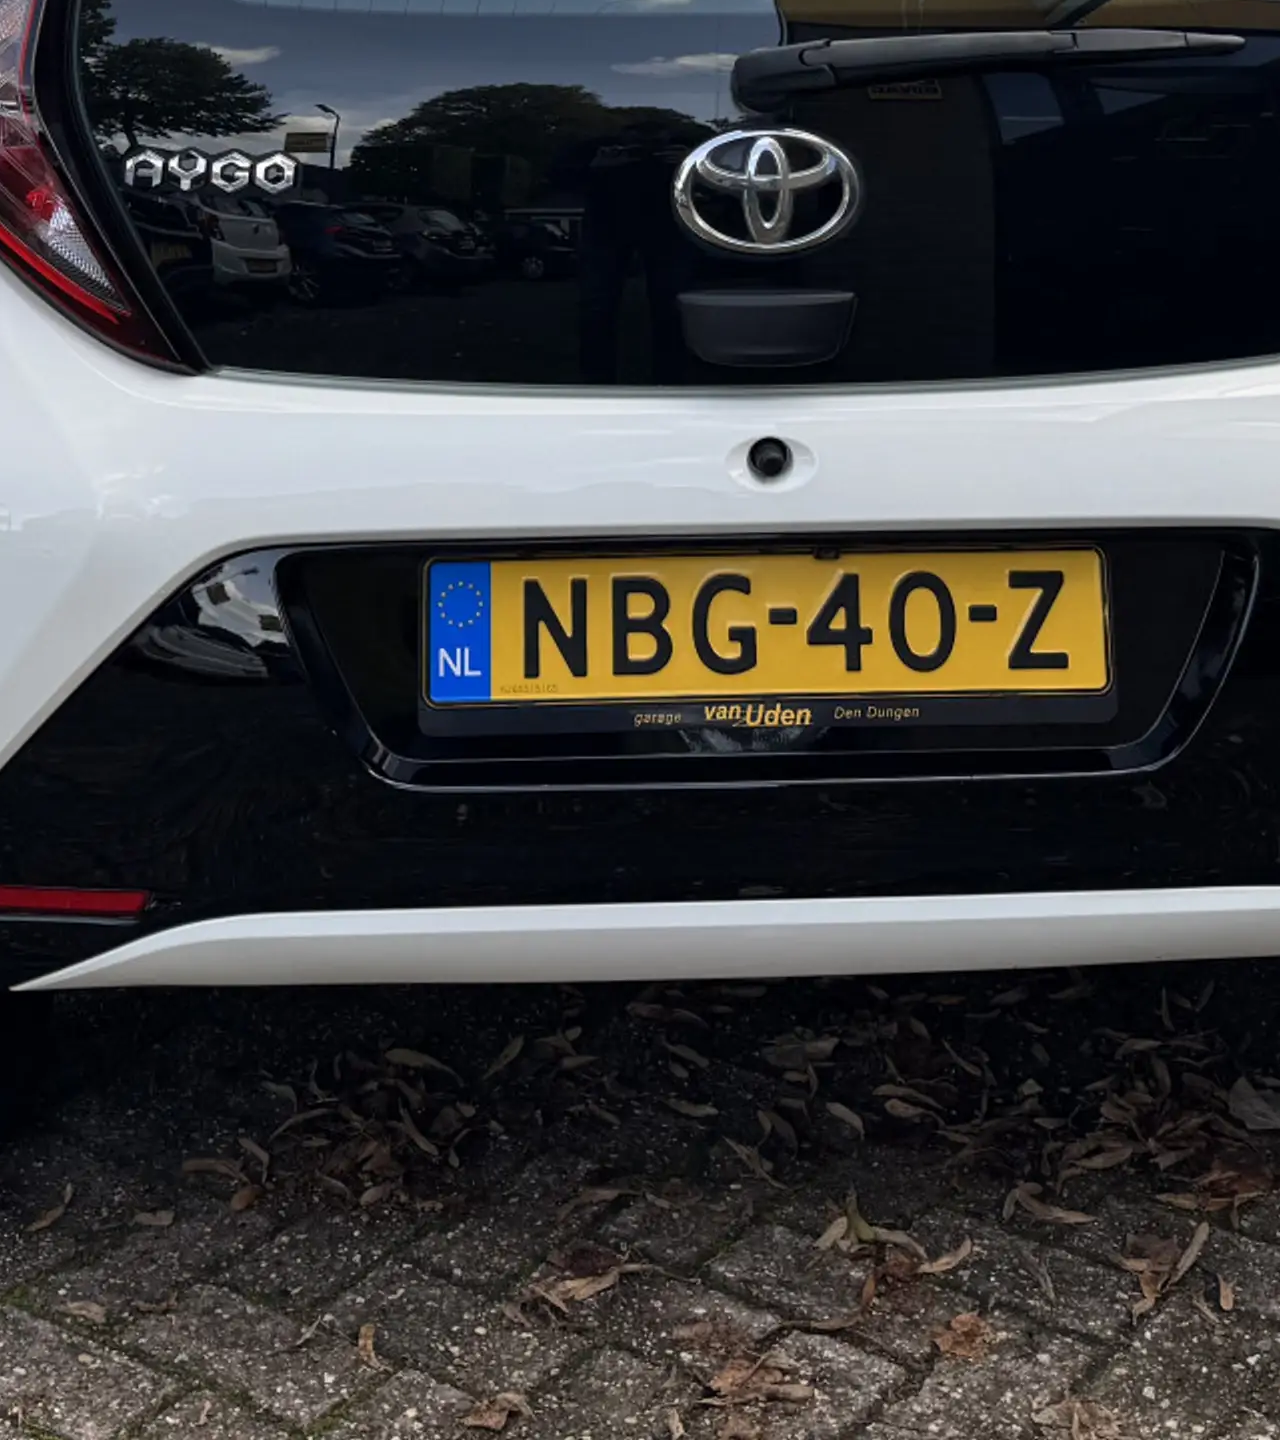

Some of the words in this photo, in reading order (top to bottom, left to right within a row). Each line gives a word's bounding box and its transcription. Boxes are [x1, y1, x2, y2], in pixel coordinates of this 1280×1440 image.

[124, 148, 299, 195] AYGO
[522, 569, 1070, 679] NBG-40-Z
[437, 647, 482, 678] NL
[633, 712, 682, 727] garage
[703, 704, 741, 721] van
[745, 702, 812, 727] Uden
[833, 706, 862, 719] Den
[867, 705, 920, 721] Dungen
